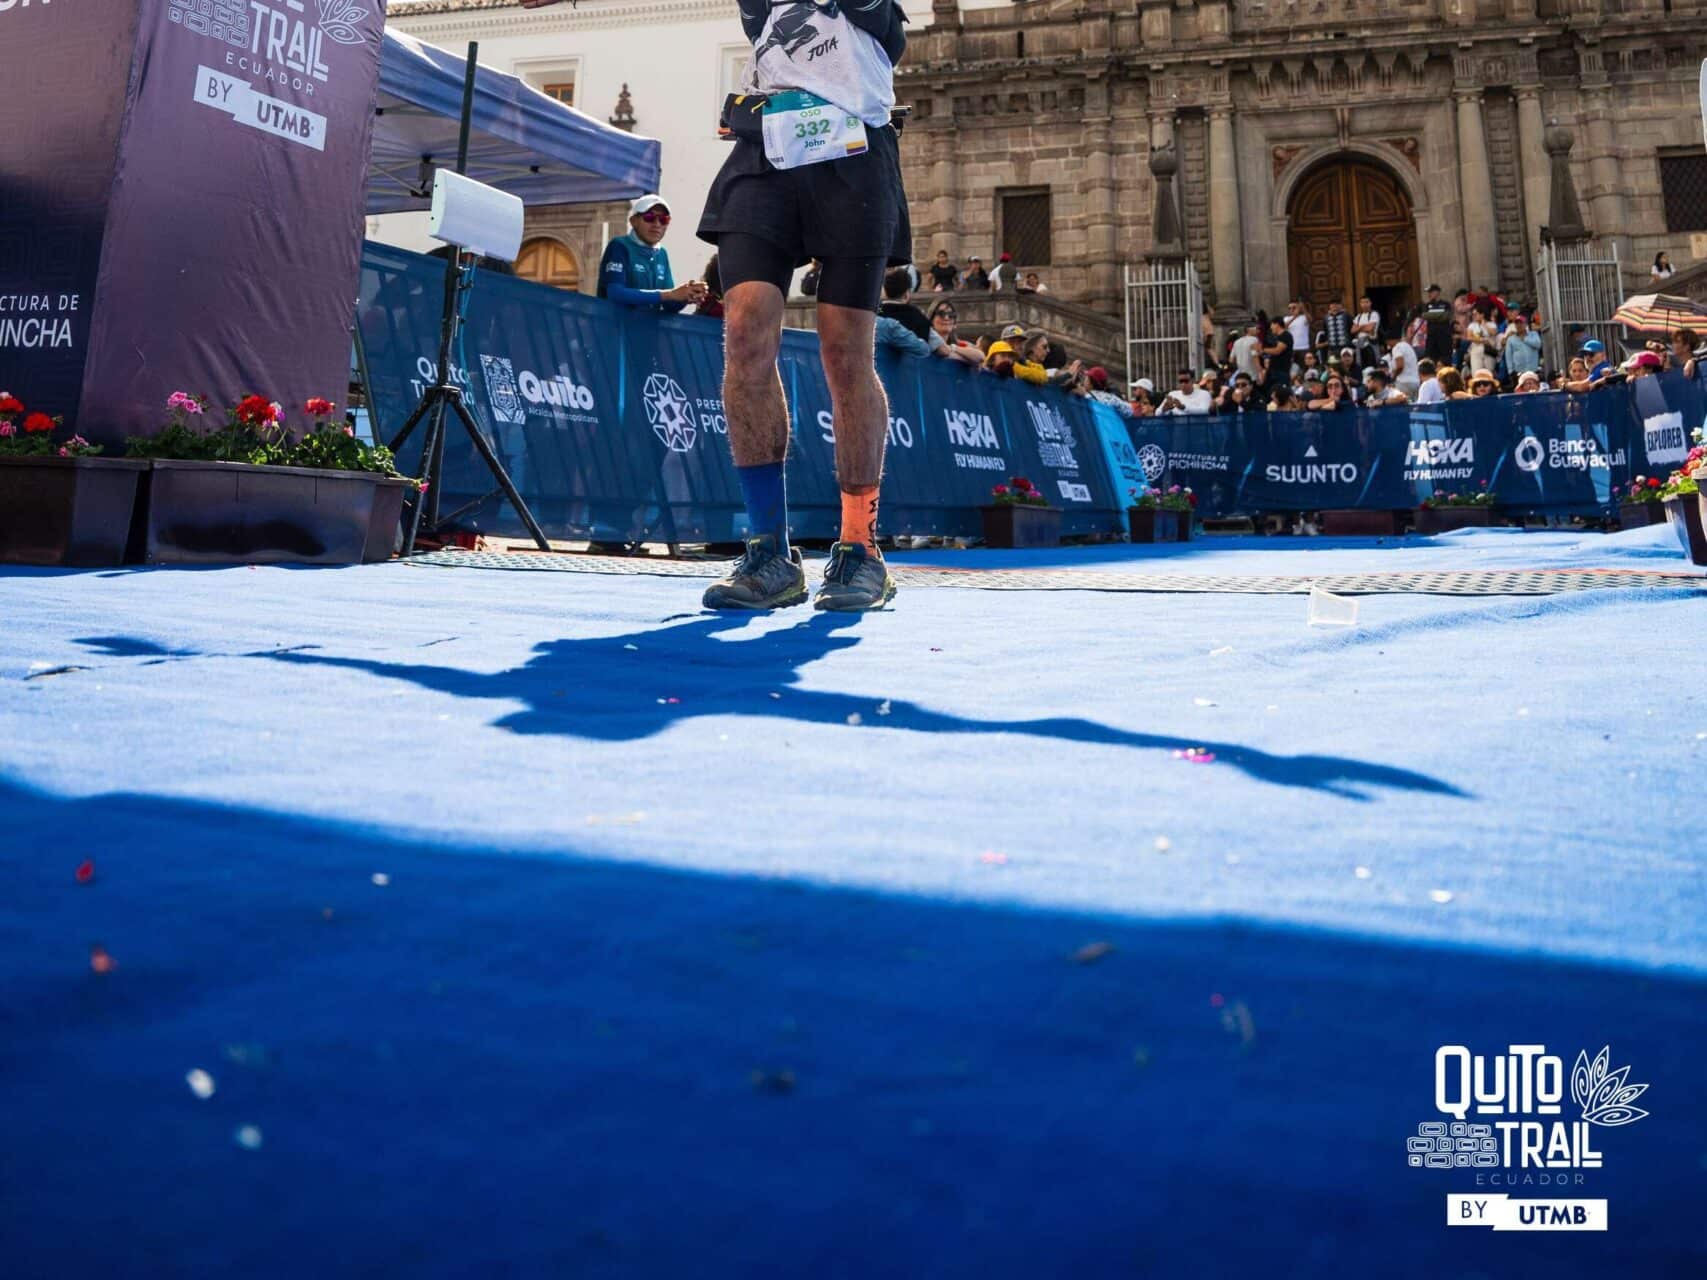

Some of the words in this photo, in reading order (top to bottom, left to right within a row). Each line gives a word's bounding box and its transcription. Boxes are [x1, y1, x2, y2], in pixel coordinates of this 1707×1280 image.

[251, 0, 329, 82] TRAIL
[225, 51, 314, 97] ECUADOR
[208, 77, 233, 103] BY
[257, 100, 312, 138] UTMB
[795, 119, 831, 138] 332
[804, 139, 826, 149] John
[58, 294, 80, 311] DE
[518, 370, 595, 411] Quito
[943, 408, 1000, 450] HOKA
[1647, 426, 1682, 452] EXPLORER
[1404, 437, 1474, 466] HOKA
[1548, 438, 1597, 453] Banco
[1168, 459, 1228, 471] PICHINCHA
[1548, 448, 1626, 472] Guayaquil
[1265, 463, 1358, 484] SUUNTO
[1403, 470, 1420, 480] FLY
[1420, 469, 1456, 480] HUMAN
[1457, 467, 1473, 479] FLY
